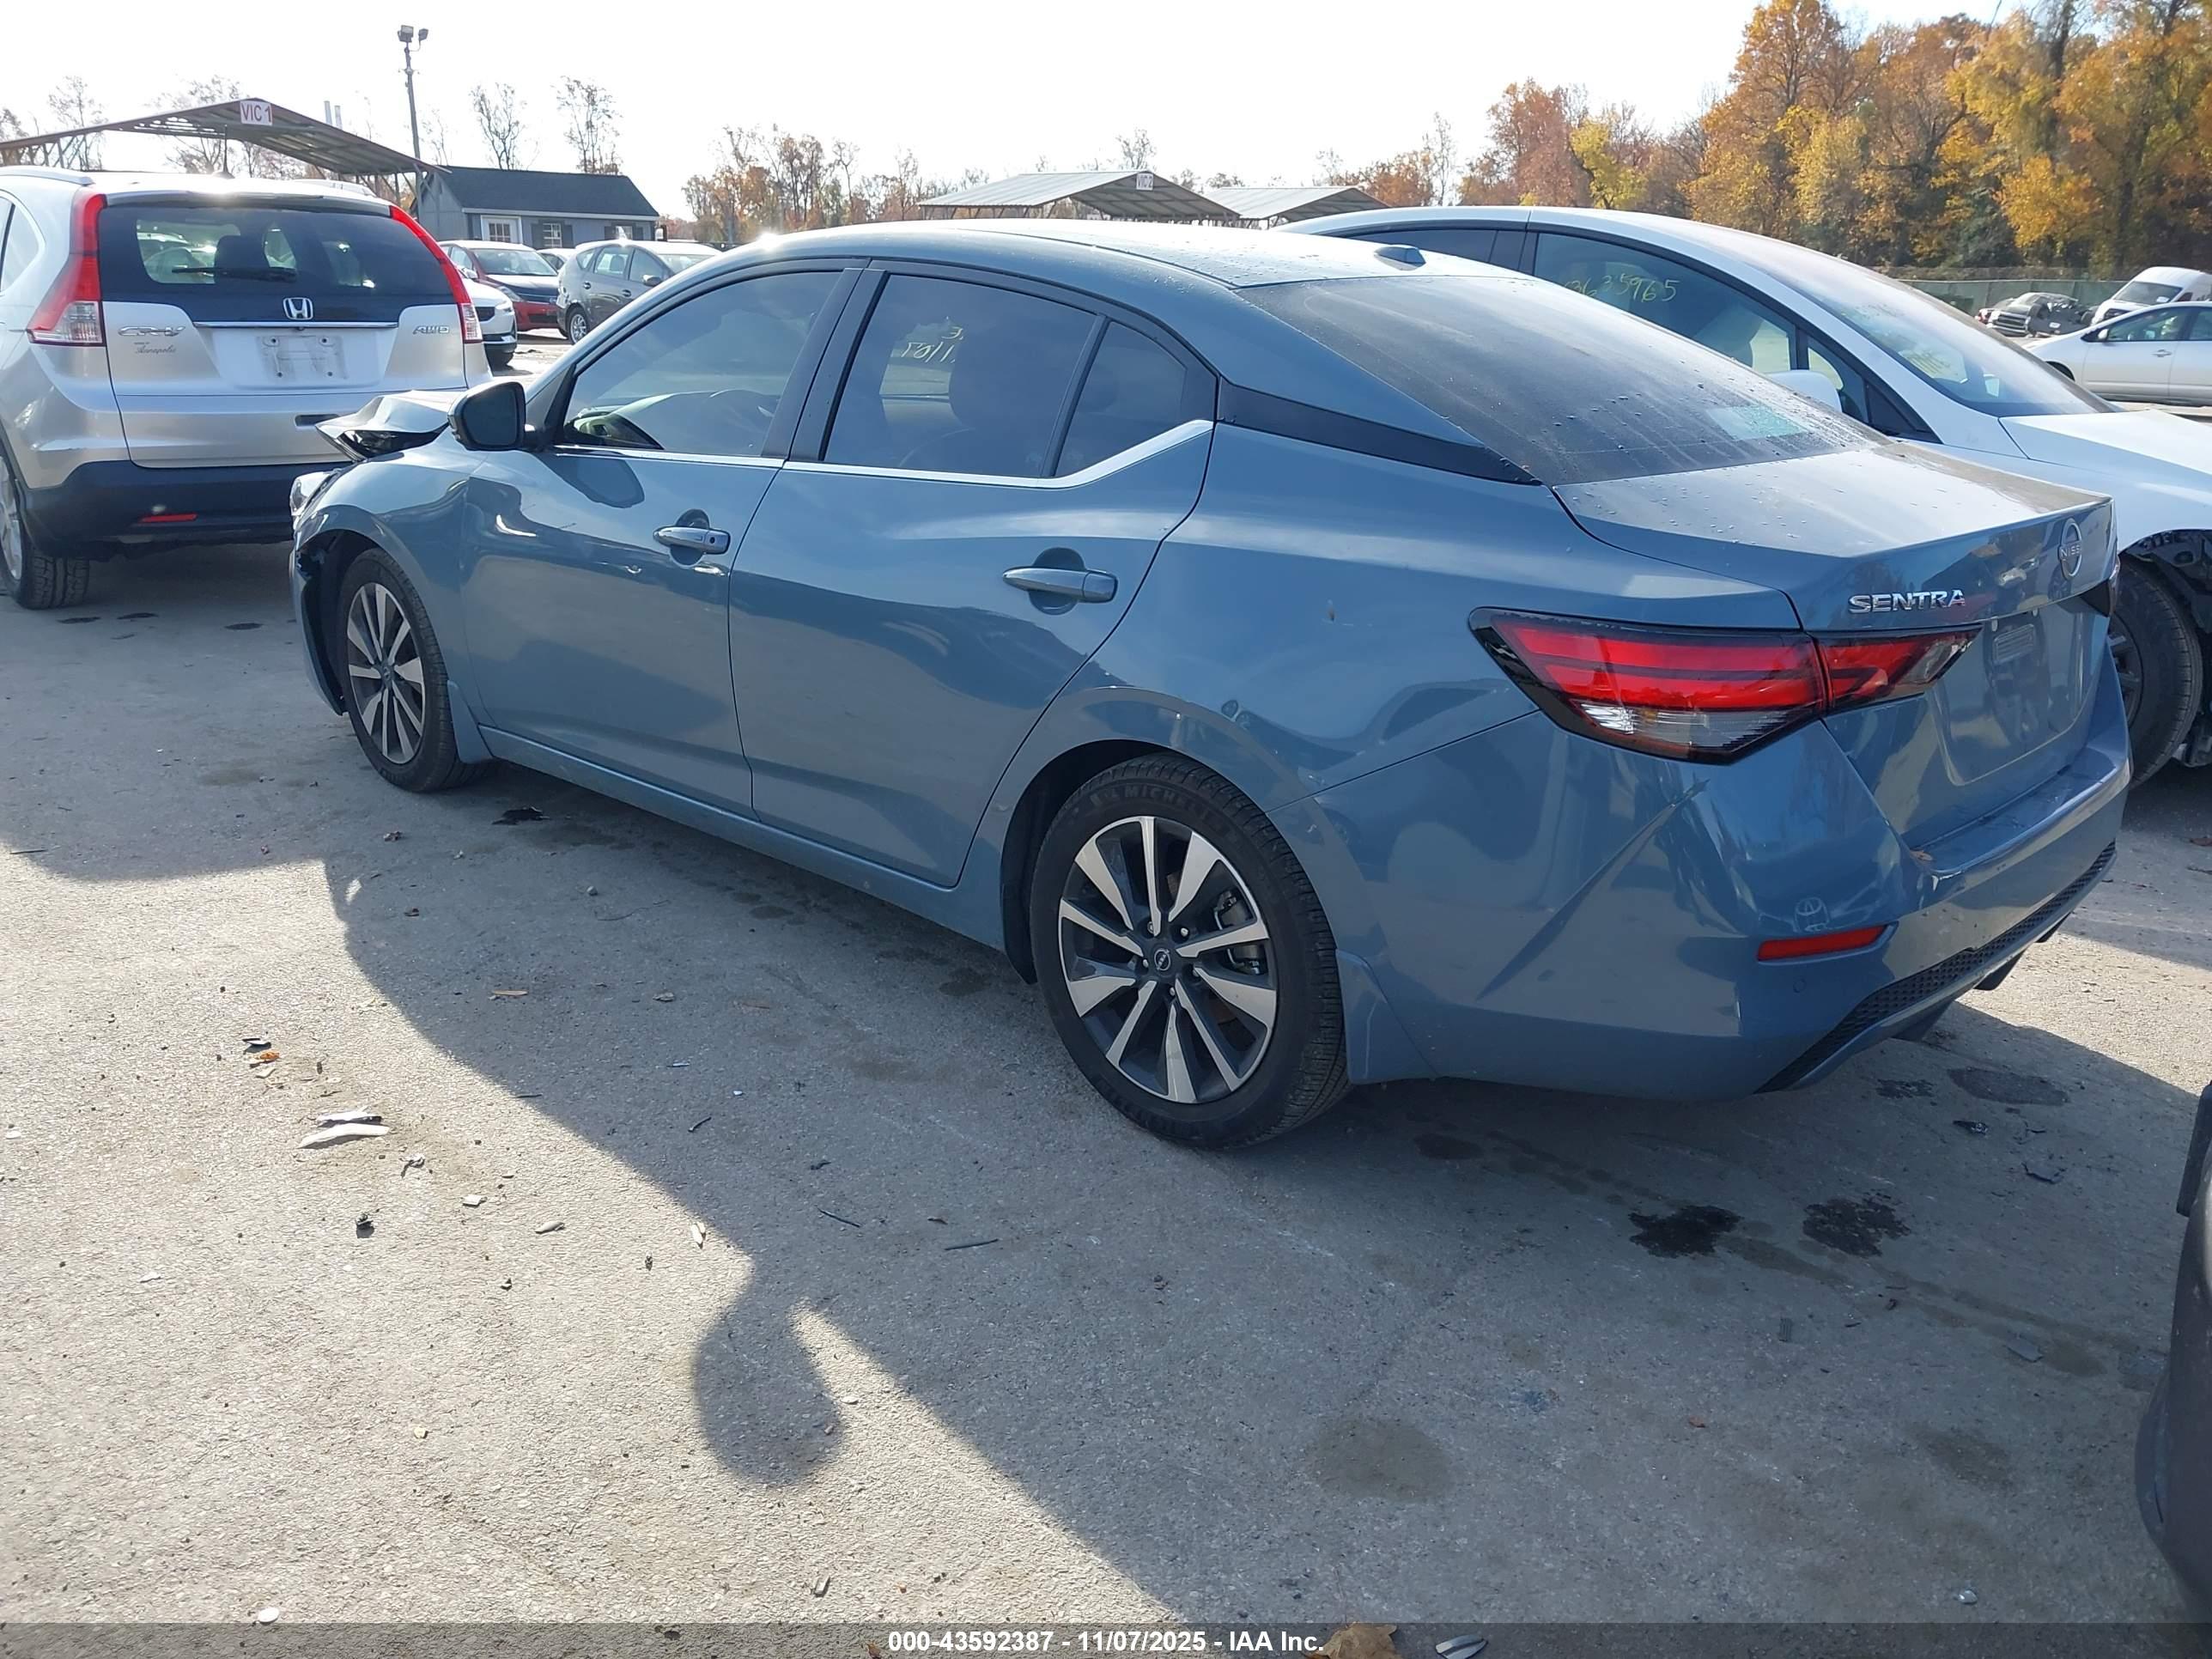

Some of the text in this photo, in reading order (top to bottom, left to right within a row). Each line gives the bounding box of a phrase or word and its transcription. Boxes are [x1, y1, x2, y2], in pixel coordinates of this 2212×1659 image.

[241, 103, 271, 122] VIC 1
[118, 325, 186, 337] CR-V
[412, 325, 450, 335] AWD
[1849, 589, 1966, 613] SENTRA
